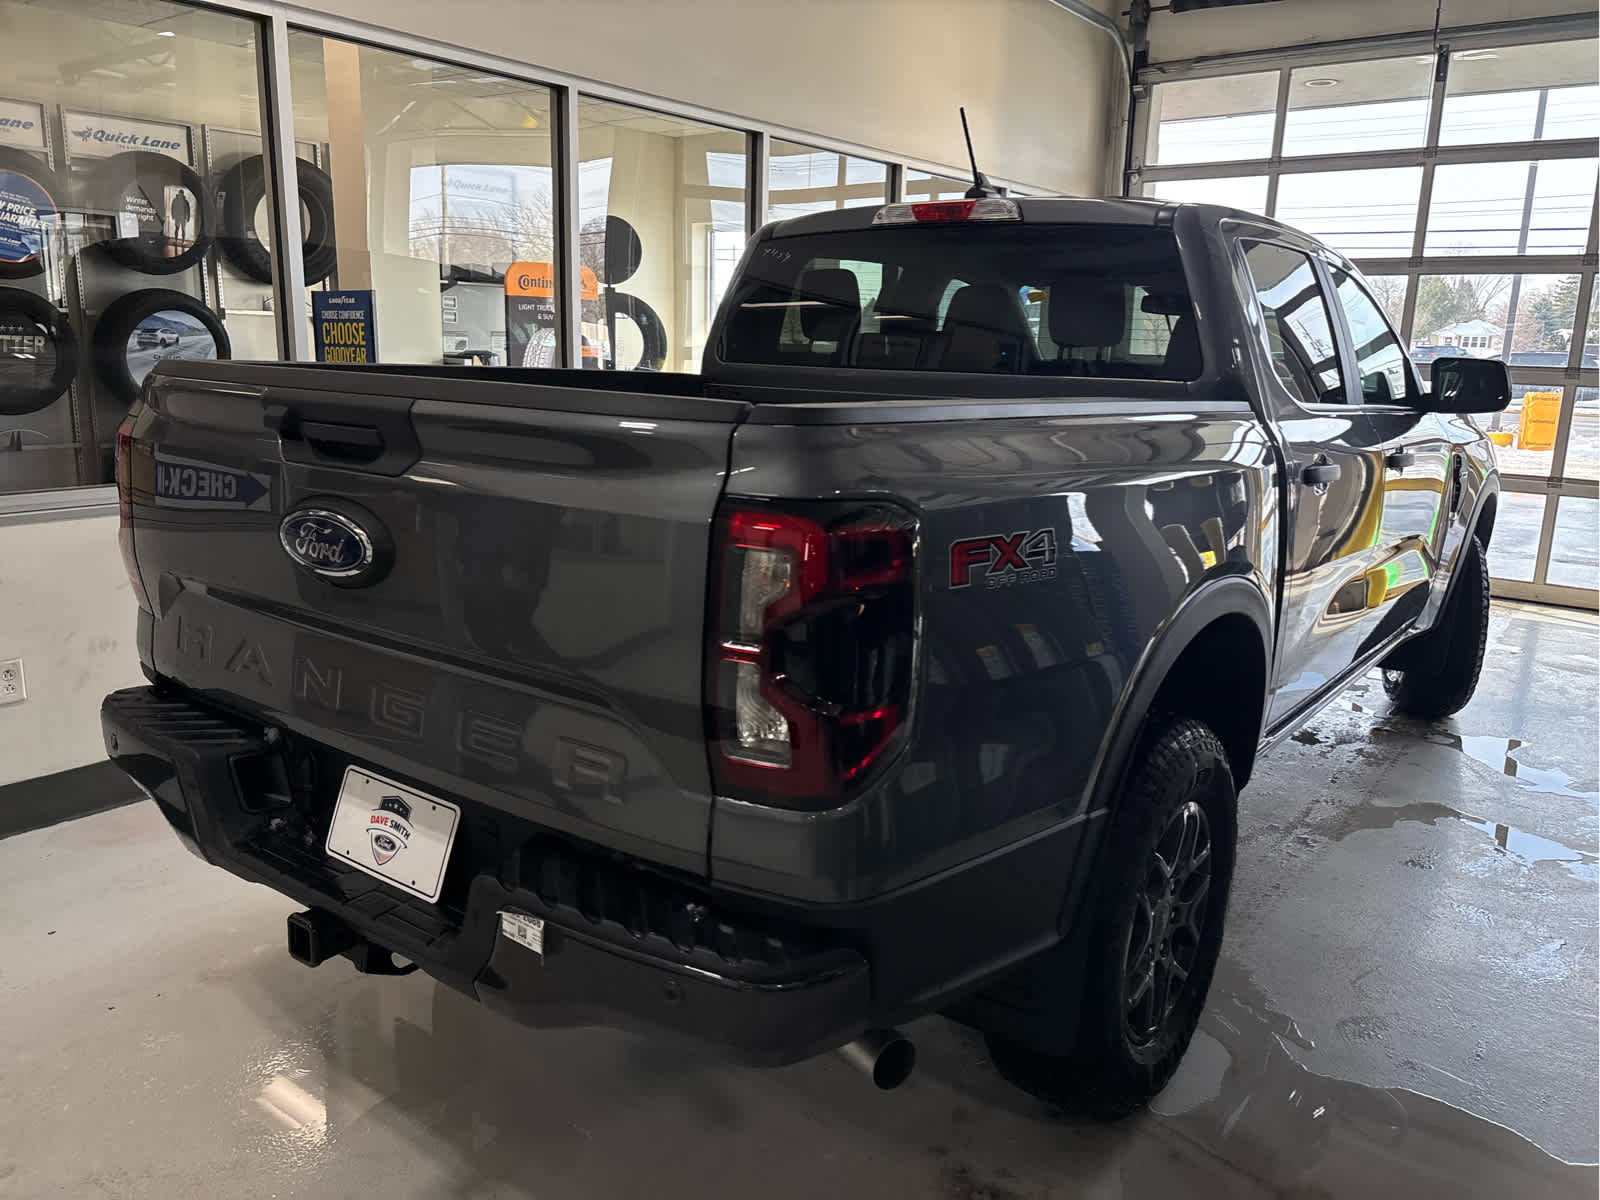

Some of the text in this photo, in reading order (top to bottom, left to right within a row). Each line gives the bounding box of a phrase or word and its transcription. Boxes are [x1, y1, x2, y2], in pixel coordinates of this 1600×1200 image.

[0, 117, 34, 130] ane
[93, 129, 140, 145] Quick
[141, 135, 181, 150] Lane
[6, 203, 37, 216] PRICE
[125, 204, 156, 214] demands
[0, 335, 46, 353] TTER
[322, 322, 366, 345] CHOOSE
[324, 346, 367, 363] GOODYEAR
[295, 522, 344, 563] Ford
[949, 528, 1057, 589] FX4
[985, 566, 1057, 590] OFF ROAD
[176, 615, 629, 806] RANGER
[370, 815, 411, 840] DAVE SMITH
